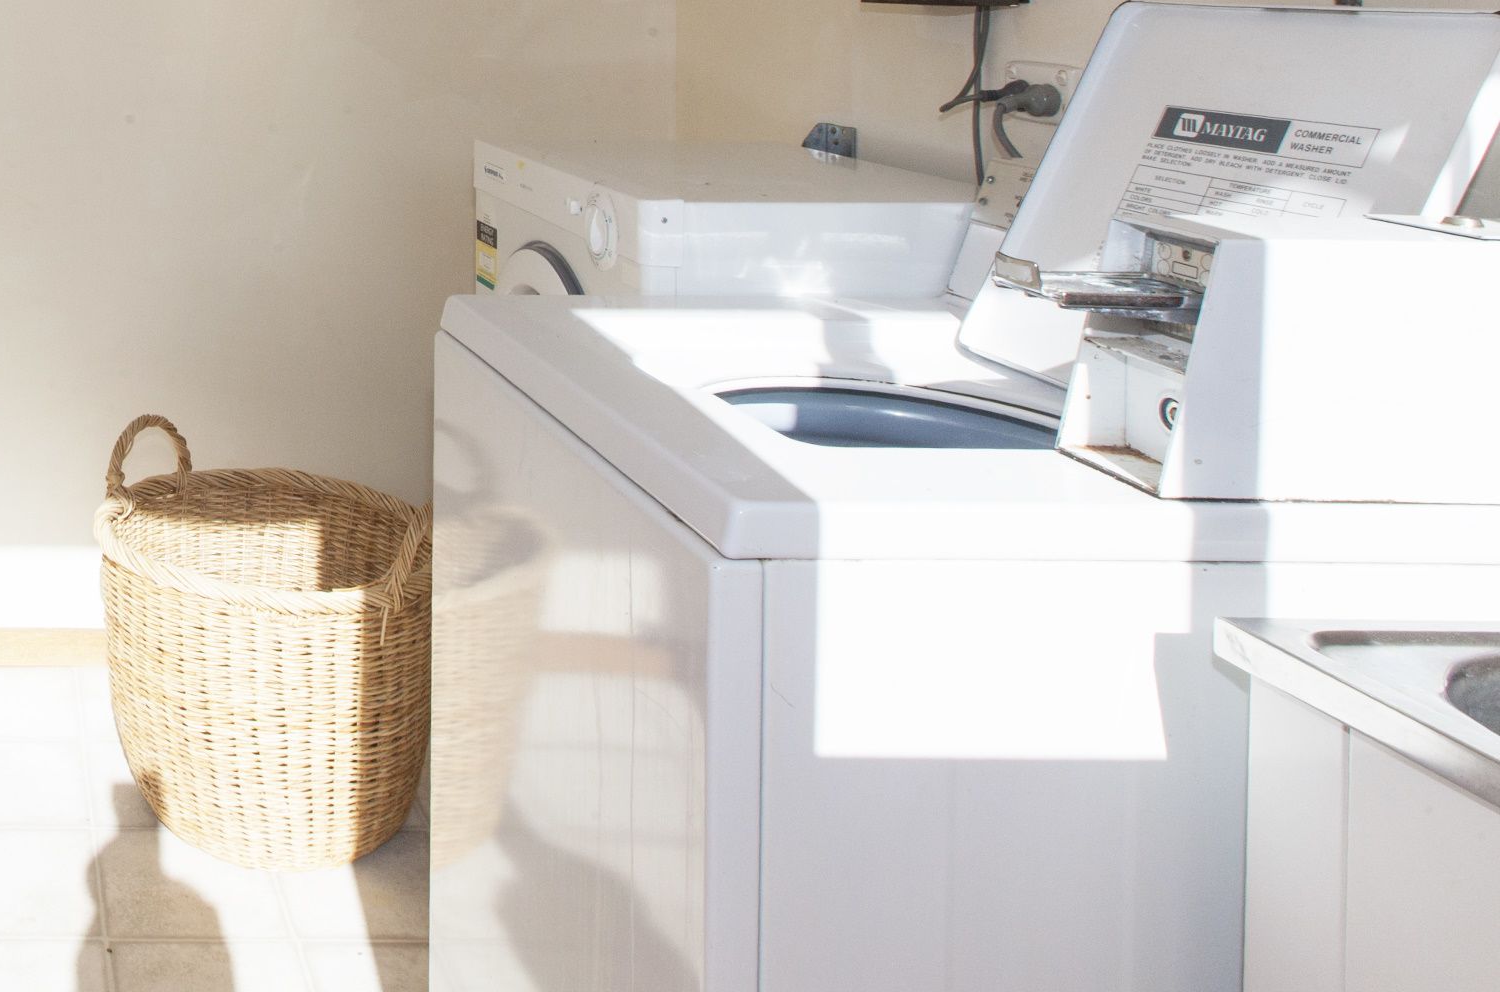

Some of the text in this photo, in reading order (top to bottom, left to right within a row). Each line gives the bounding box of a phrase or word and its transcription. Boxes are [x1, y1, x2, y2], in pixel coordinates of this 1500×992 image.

[1201, 122, 1268, 142] MAYTAG
[1294, 129, 1362, 145] COMMERCIAL
[1290, 142, 1334, 155] WASHER
[1285, 162, 1320, 173] MEASURED
[1323, 168, 1352, 177] AMOUNT
[1308, 173, 1332, 182] CLOSE
